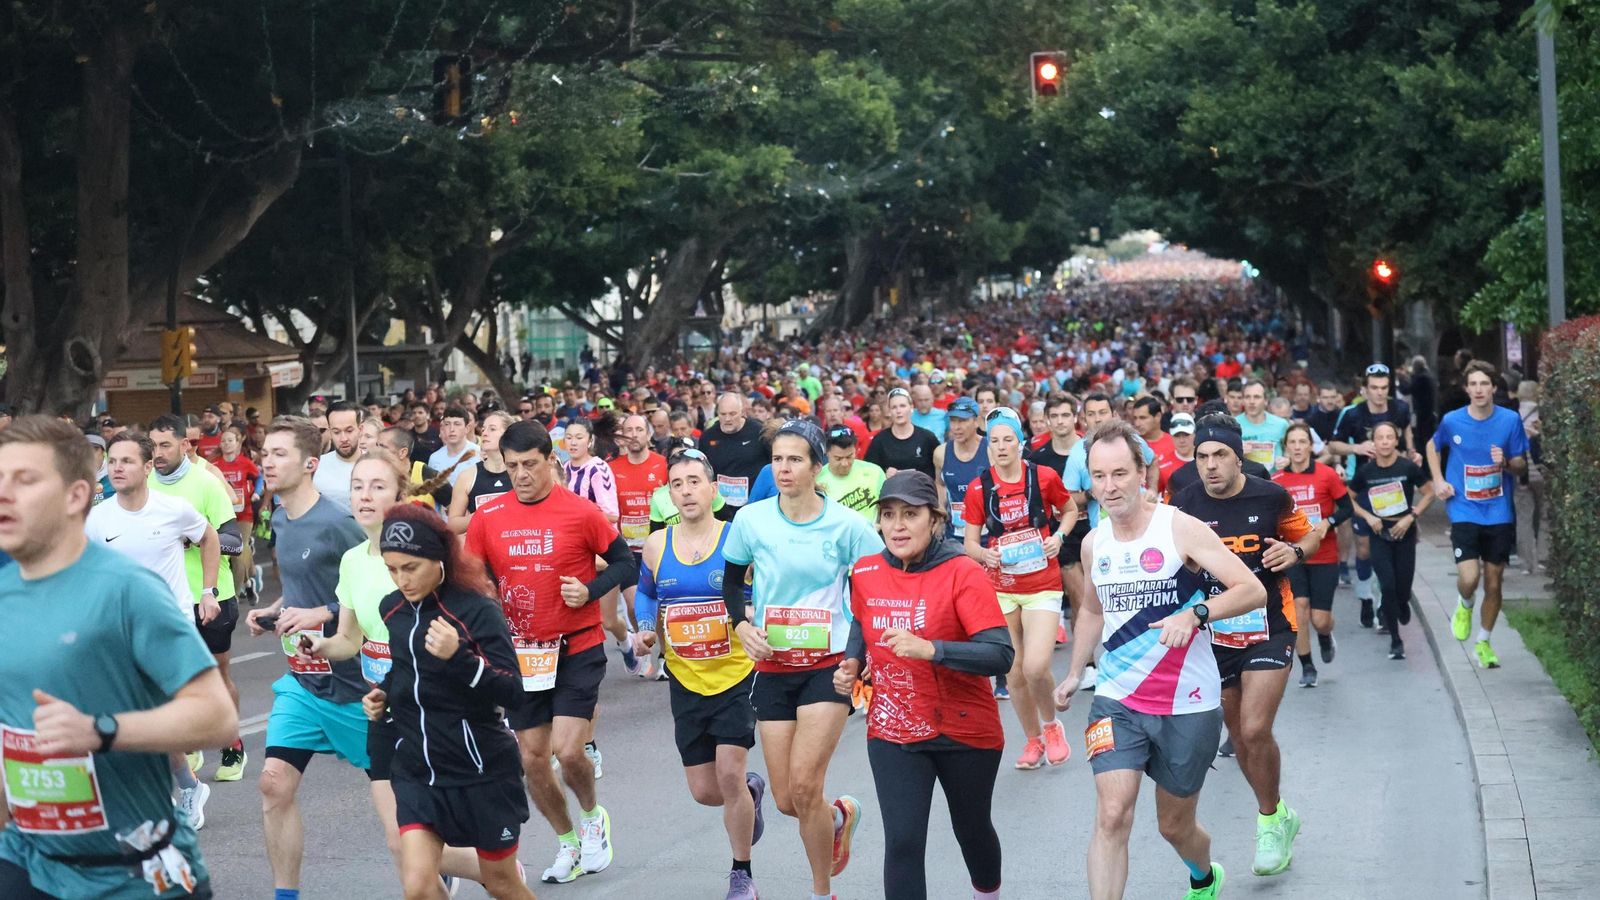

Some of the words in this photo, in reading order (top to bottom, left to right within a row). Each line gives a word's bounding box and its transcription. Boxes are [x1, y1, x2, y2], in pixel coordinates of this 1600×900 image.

[508, 543, 542, 556] MÁLAGA
[1008, 545, 1035, 558] 17423
[1136, 576, 1178, 592] MARATÓN
[1113, 590, 1180, 612] ESTEPONA
[681, 603, 721, 615] GENERALI
[782, 609, 827, 620] GENERALI
[681, 622, 711, 636] 3131
[872, 614, 912, 631] MÁLAGA
[785, 628, 809, 640] 820
[19, 767, 66, 788] 2753
